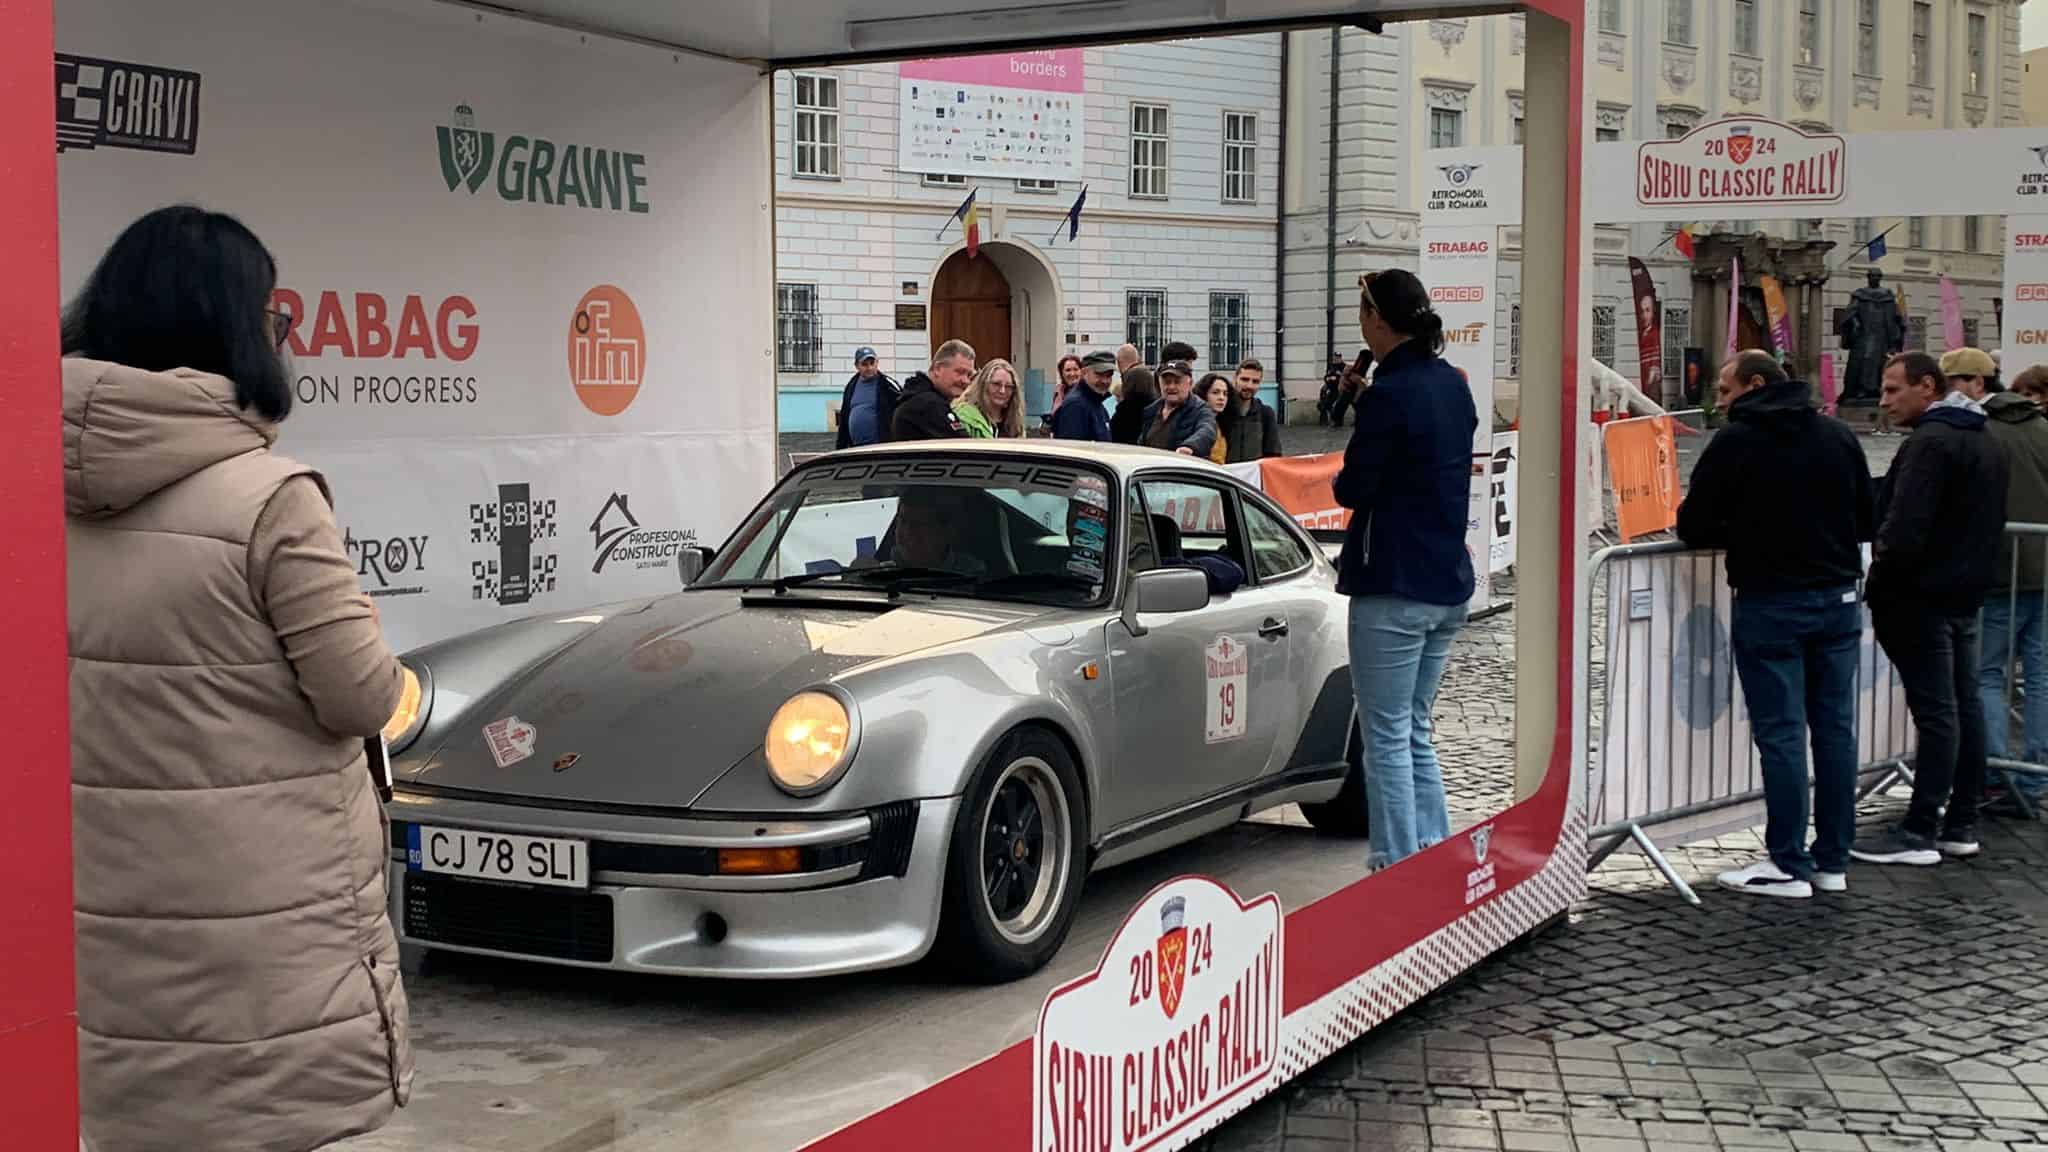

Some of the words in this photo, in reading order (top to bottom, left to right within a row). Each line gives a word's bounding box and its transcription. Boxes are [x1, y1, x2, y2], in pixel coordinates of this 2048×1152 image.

[1010, 57, 1067, 78] borders
[1704, 140, 1724, 156] 20
[1756, 138, 1776, 154] 24
[497, 135, 650, 213] GRAWE
[1643, 155, 1691, 198] SIBIU
[1699, 167, 1776, 197] CLASSIC
[1782, 148, 1839, 195] RALLY
[1432, 189, 1485, 199] RETROMOBIL
[2016, 185, 2038, 195] CLUB
[1427, 201, 1445, 210] CLUB
[1448, 200, 1488, 209] ROMANIA
[1428, 242, 1489, 253] STRABAG
[296, 376, 339, 404] ON
[354, 375, 477, 404] PROGRESS
[799, 462, 1079, 490] PORSCHE
[503, 502, 528, 526] SB
[629, 529, 697, 545] PROFESIONAL
[611, 543, 679, 562] CONSTRUCT
[1219, 683, 1235, 727] 19
[430, 832, 467, 870] CJ
[477, 836, 514, 874] 78
[527, 841, 576, 881] SLI
[1129, 950, 1152, 1007] 20
[1191, 922, 1213, 976] 24
[1049, 1040, 1113, 1152] SIBIU
[1122, 1013, 1211, 1147] CLASSIC
[1217, 931, 1274, 1092] RALLY
